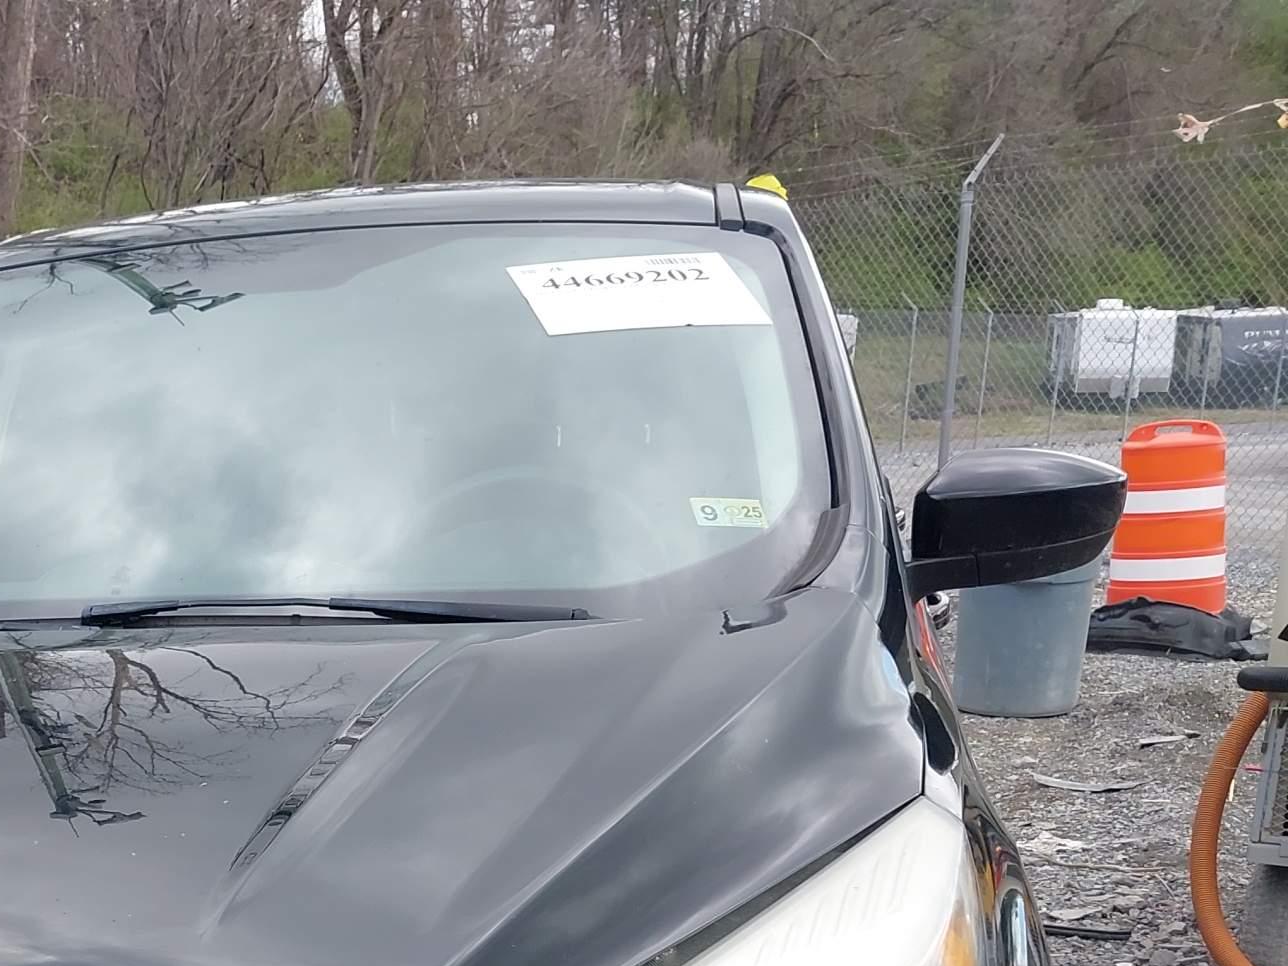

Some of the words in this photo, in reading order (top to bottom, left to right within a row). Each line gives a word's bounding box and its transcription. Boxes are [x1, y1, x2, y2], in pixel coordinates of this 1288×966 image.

[541, 268, 710, 290] 44669202
[700, 504, 718, 521] 9
[741, 505, 762, 519] 25
